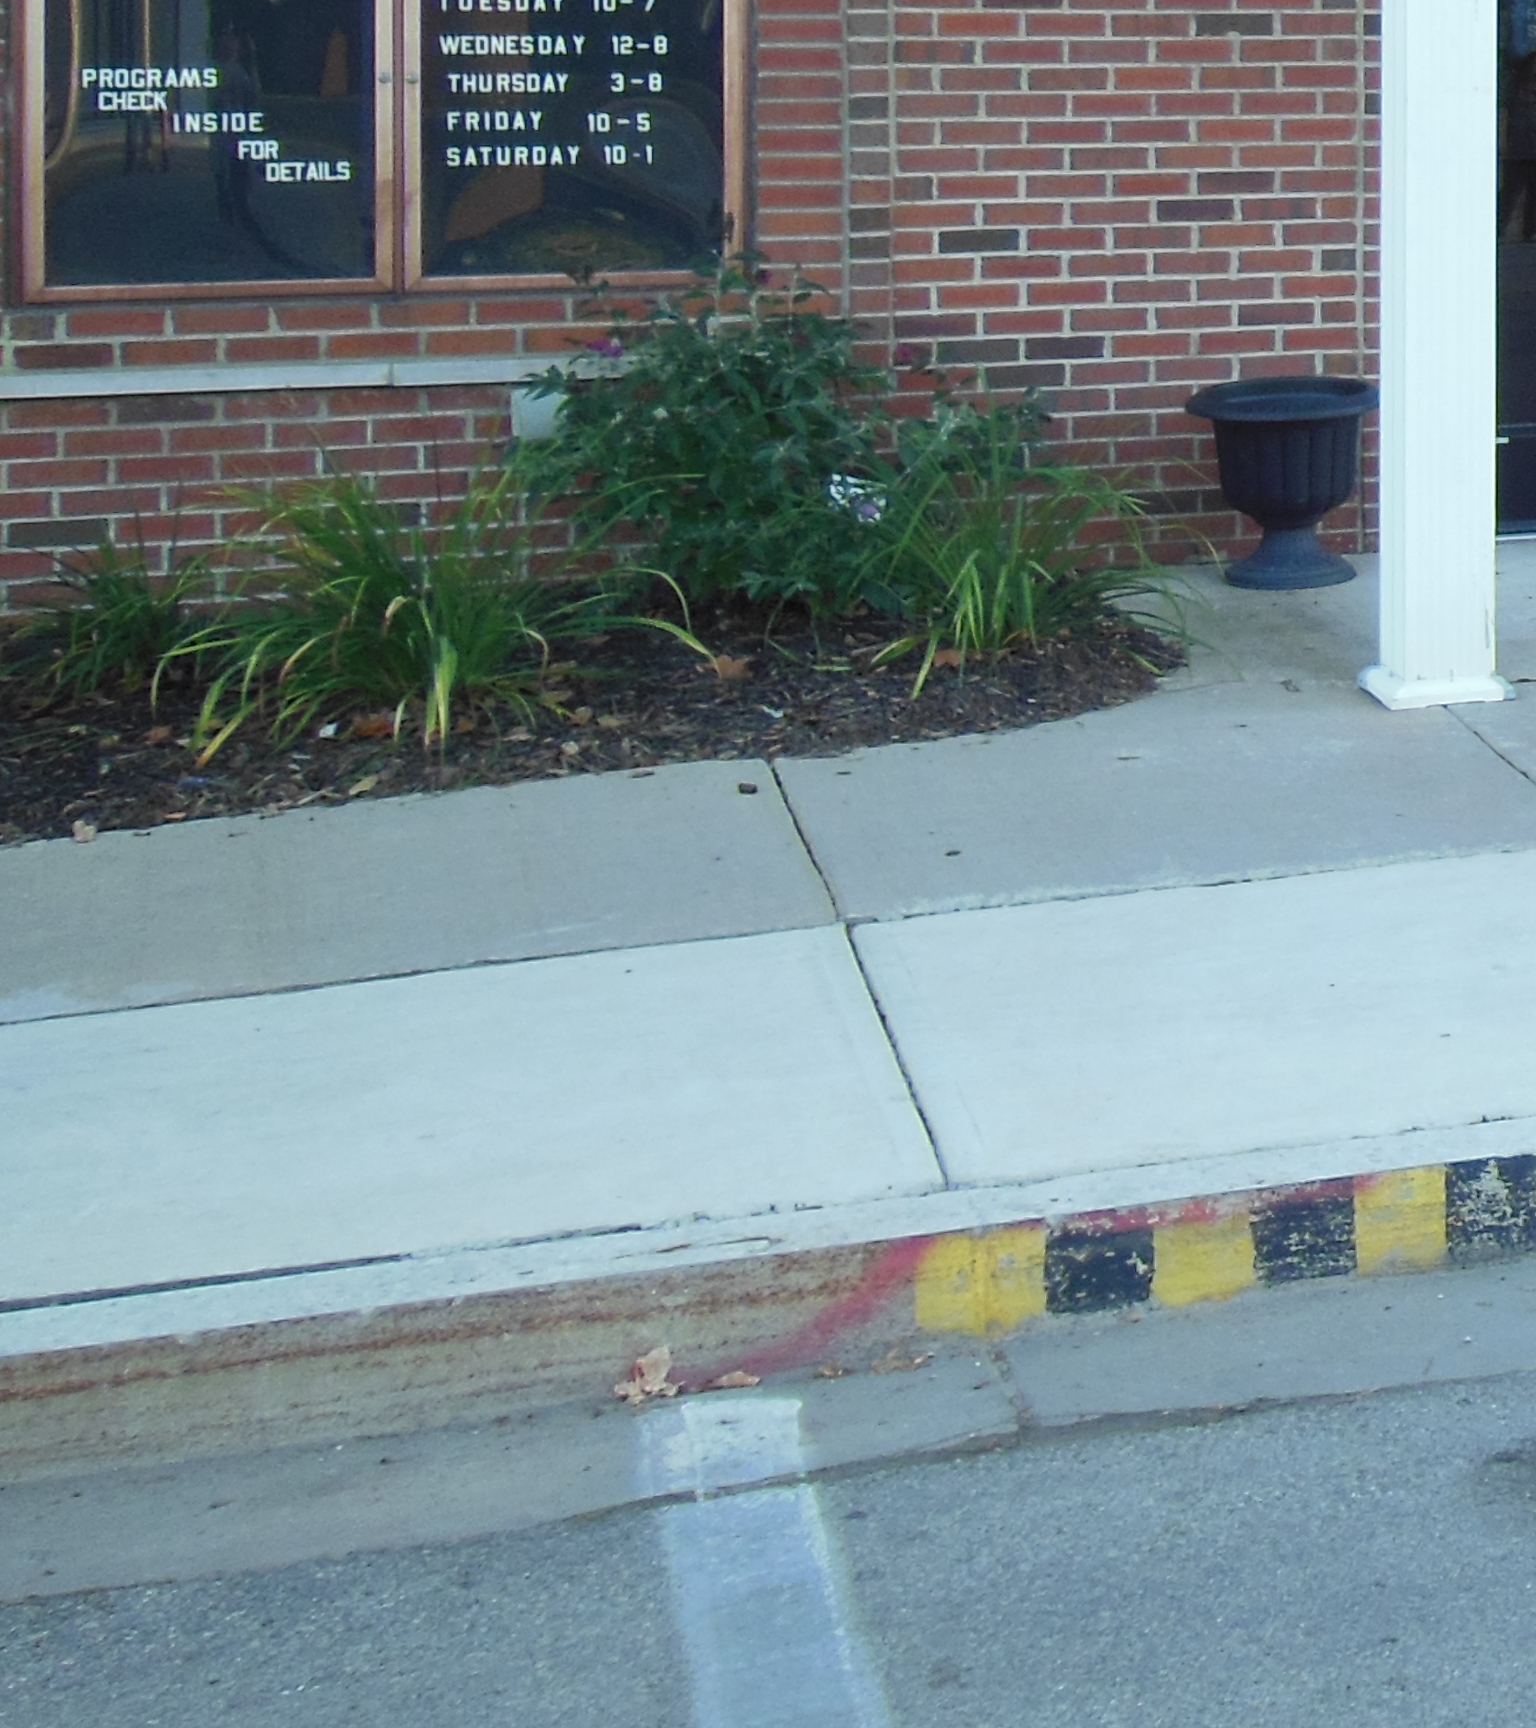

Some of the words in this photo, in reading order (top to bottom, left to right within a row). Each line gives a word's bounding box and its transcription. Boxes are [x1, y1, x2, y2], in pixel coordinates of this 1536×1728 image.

[439, 34, 586, 56] WEDNESDAY
[81, 68, 219, 88] PROGRAMS
[448, 73, 569, 94] THURSDAY
[98, 91, 168, 111] CHECK
[172, 112, 264, 133] INSIDE
[446, 110, 543, 132] FRIDAY
[237, 140, 280, 160] FOR
[446, 145, 580, 167] SATURDAY
[265, 161, 351, 182] DETAILS
